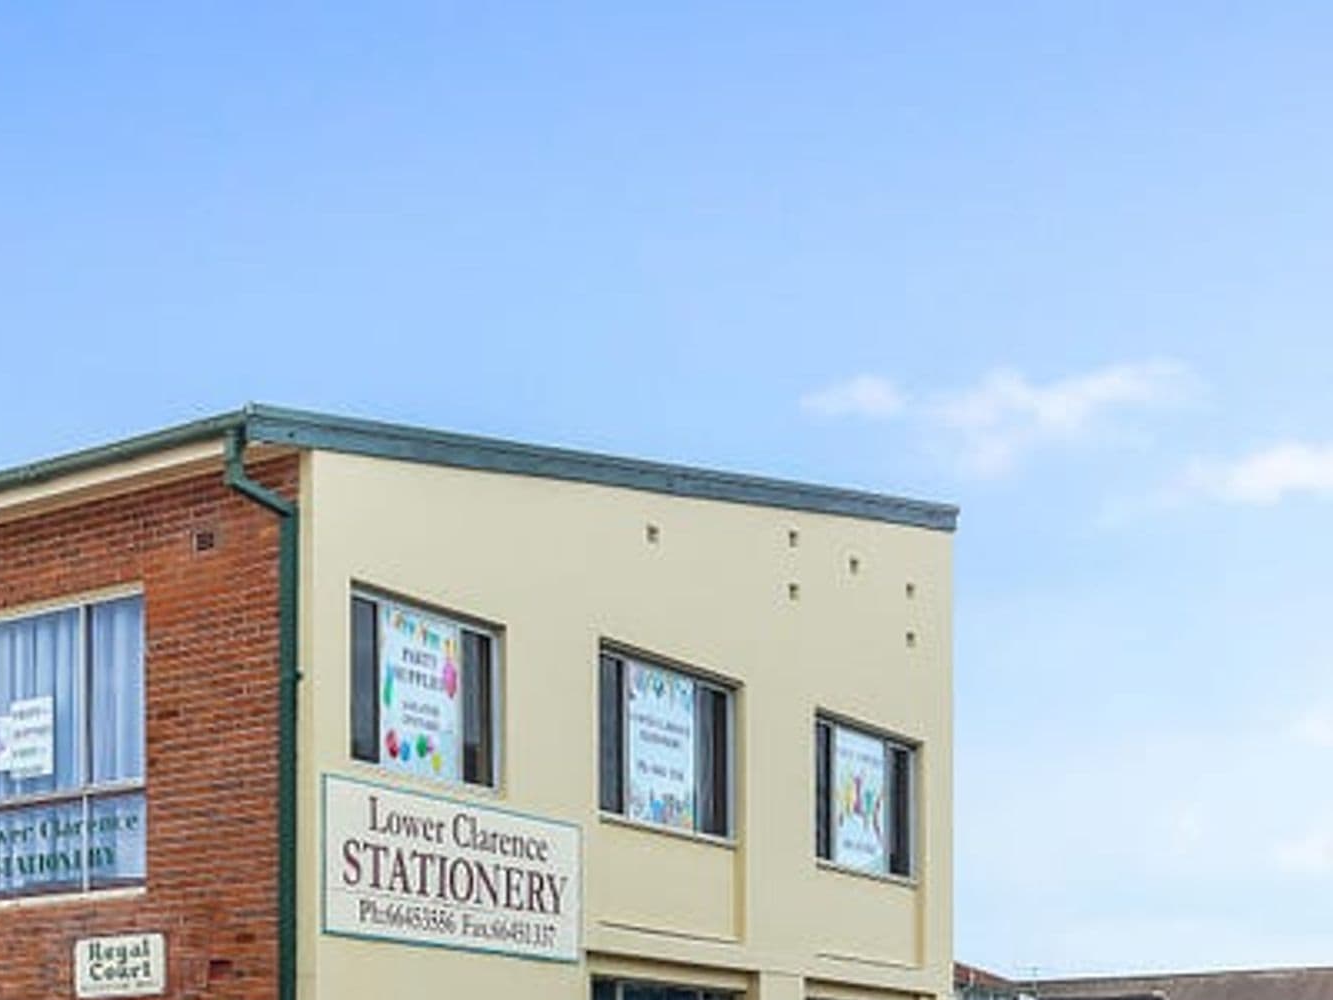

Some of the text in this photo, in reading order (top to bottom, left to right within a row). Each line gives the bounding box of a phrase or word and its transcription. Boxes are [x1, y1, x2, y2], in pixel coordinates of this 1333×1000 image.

[40, 814, 138, 839] Clarence
[368, 797, 548, 861] Lower Clarence
[343, 838, 568, 915] STATIONERY
[89, 939, 150, 965] Royal
[89, 960, 150, 981] Court
